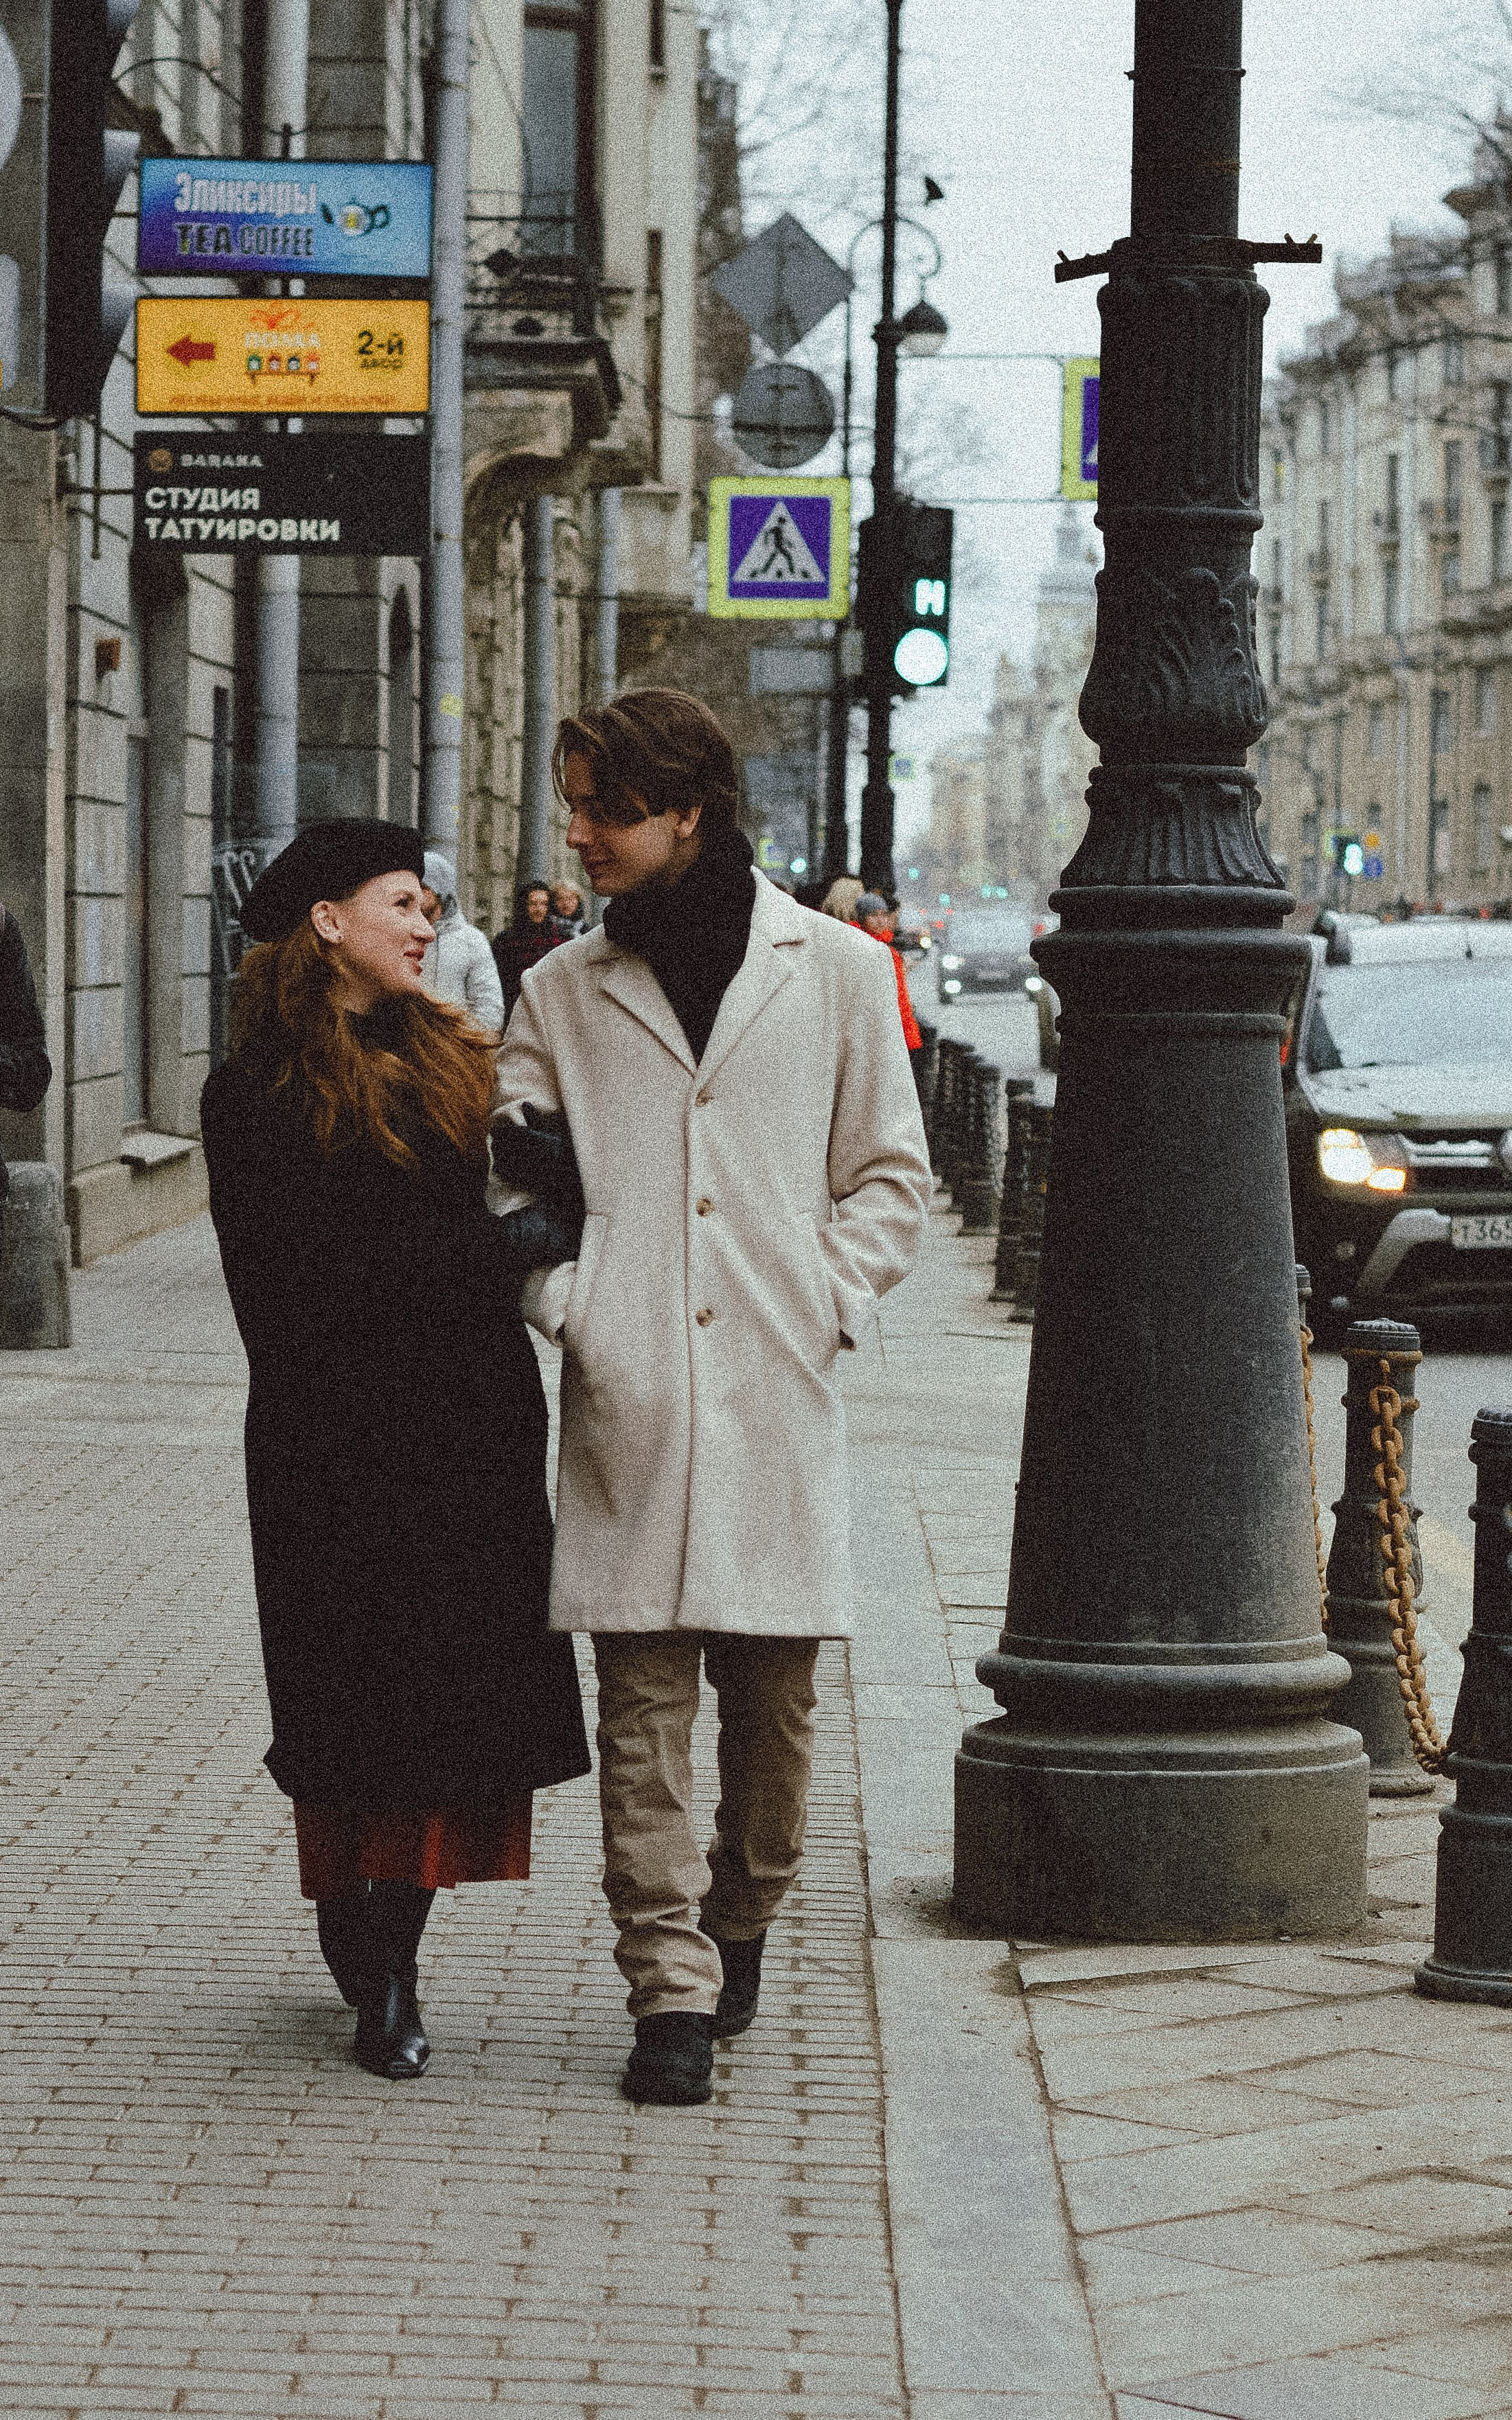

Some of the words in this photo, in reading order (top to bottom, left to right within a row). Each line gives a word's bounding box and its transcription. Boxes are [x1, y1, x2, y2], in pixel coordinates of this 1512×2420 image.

[174, 172, 317, 218] Эликсиры
[175, 223, 232, 255] TEA
[239, 225, 314, 256] COFFEE
[145, 487, 260, 512] СТУДИЯ
[145, 517, 341, 542] ТАТУИРОВКИ
